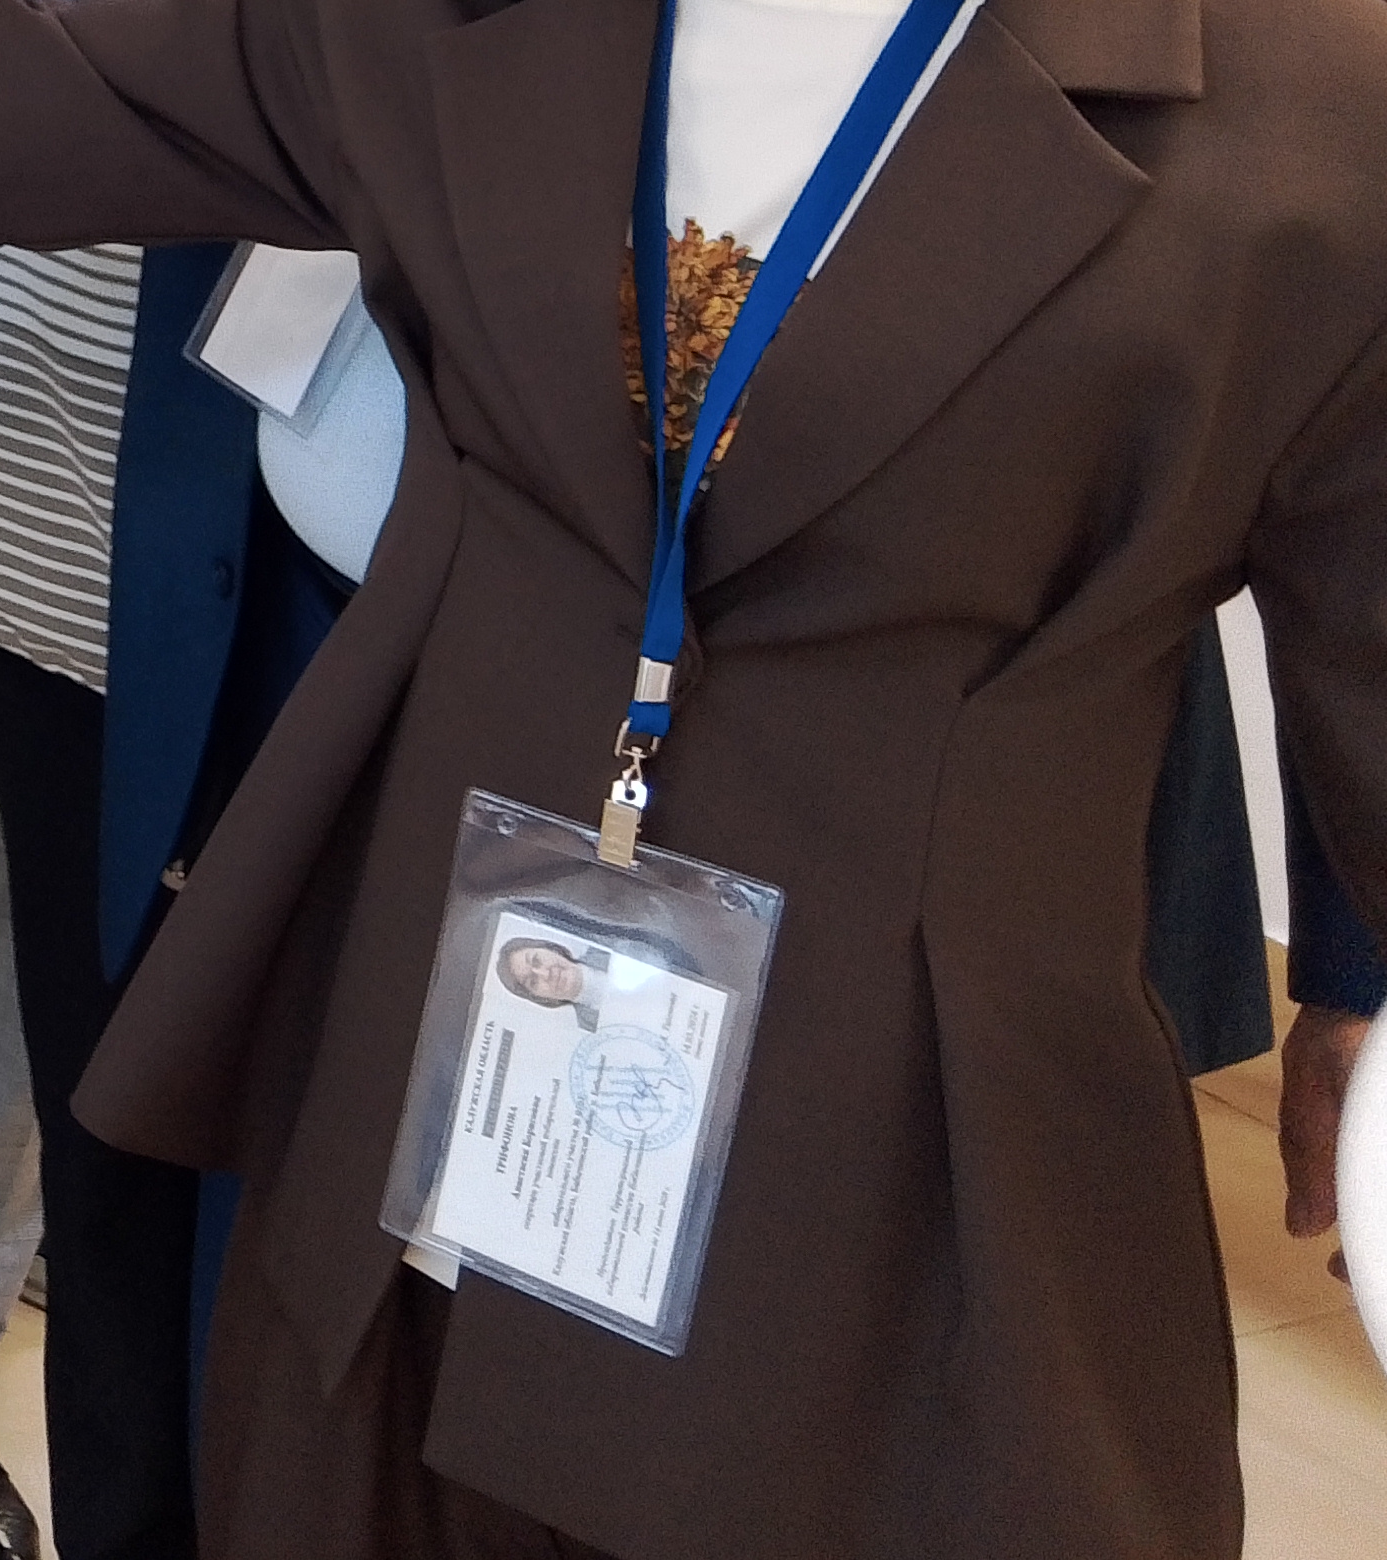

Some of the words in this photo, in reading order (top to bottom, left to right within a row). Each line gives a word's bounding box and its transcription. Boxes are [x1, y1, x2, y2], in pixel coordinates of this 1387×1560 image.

[463, 1067, 485, 1134] КАЛУЖСКАЯ
[477, 1018, 495, 1068] ОБЛАСТЬ
[495, 1104, 519, 1175] ТРИФОНОВА
